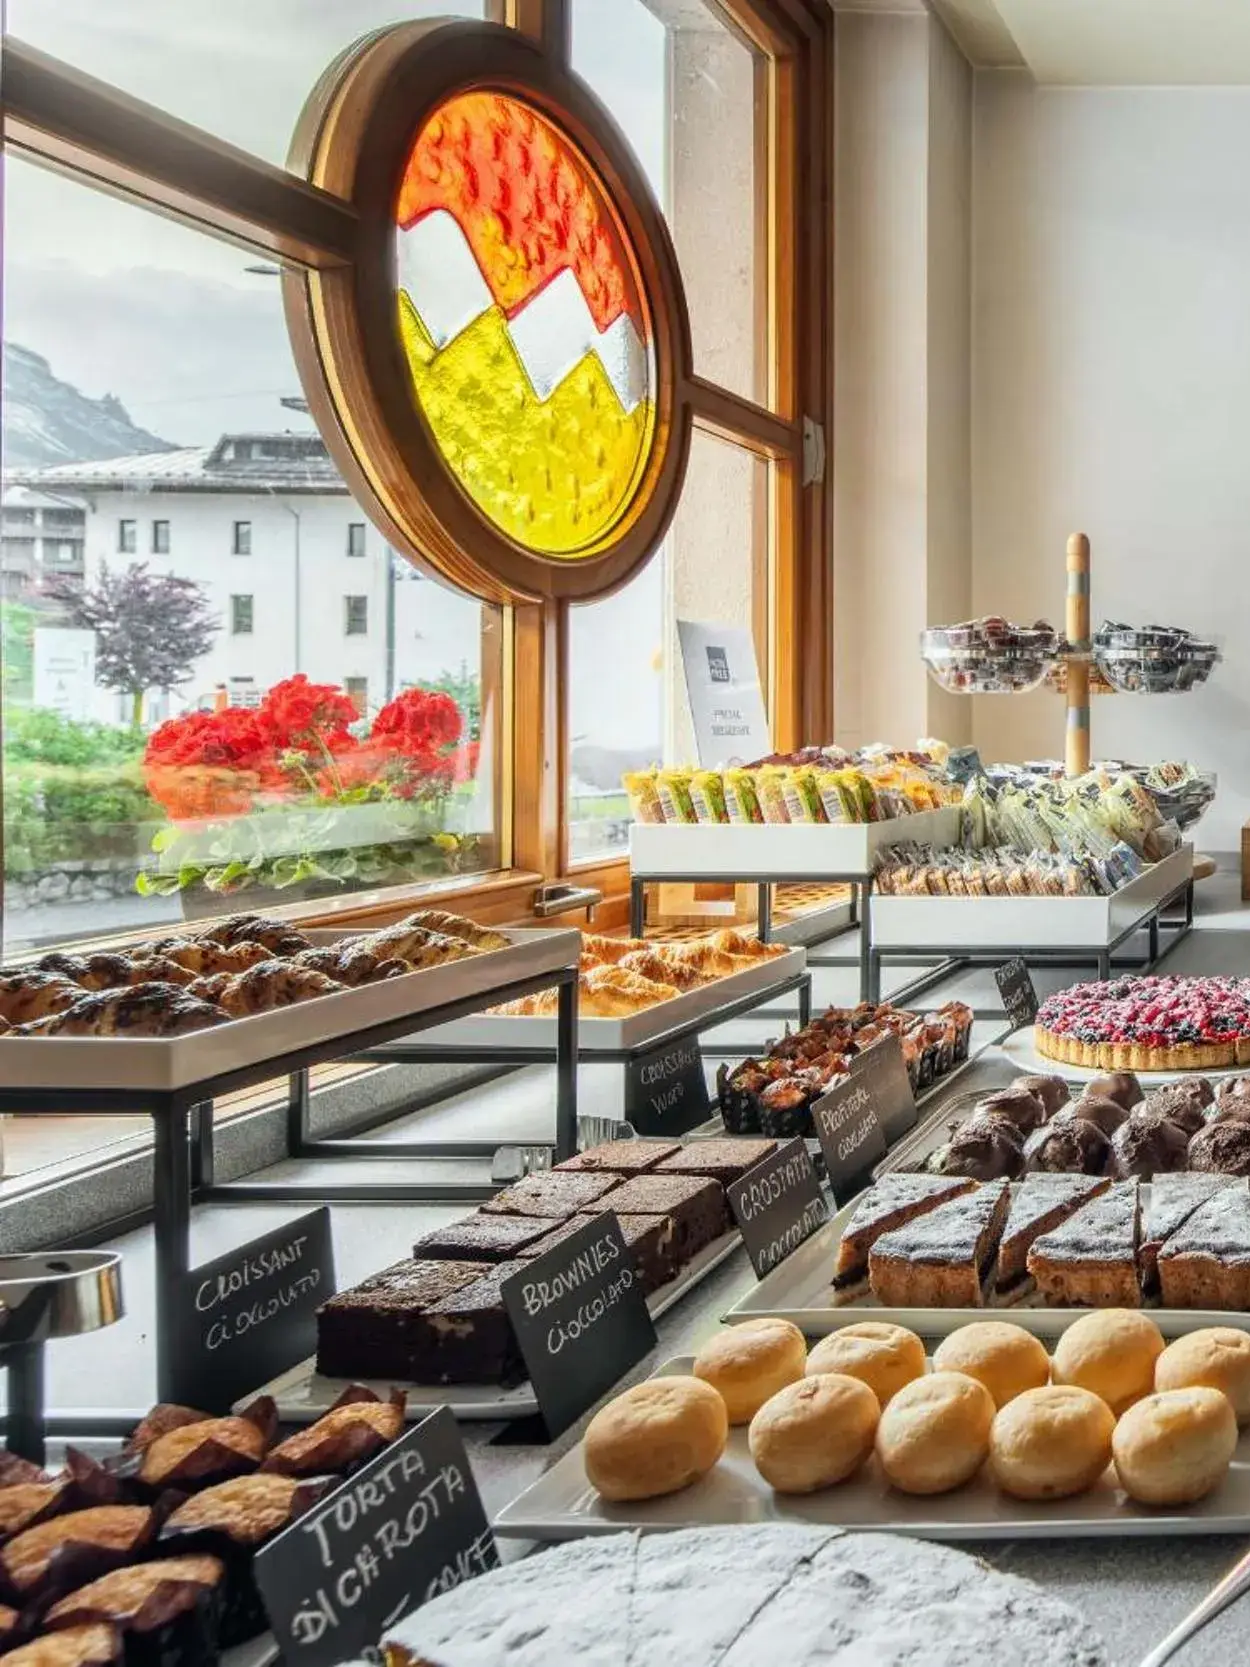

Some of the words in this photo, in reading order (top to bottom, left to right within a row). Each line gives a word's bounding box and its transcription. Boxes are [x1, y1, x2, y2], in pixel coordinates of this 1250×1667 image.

[740, 1151, 811, 1221] CROSTATA
[521, 1234, 620, 1316] BROWNIES
[303, 1449, 426, 1568] TORTA
